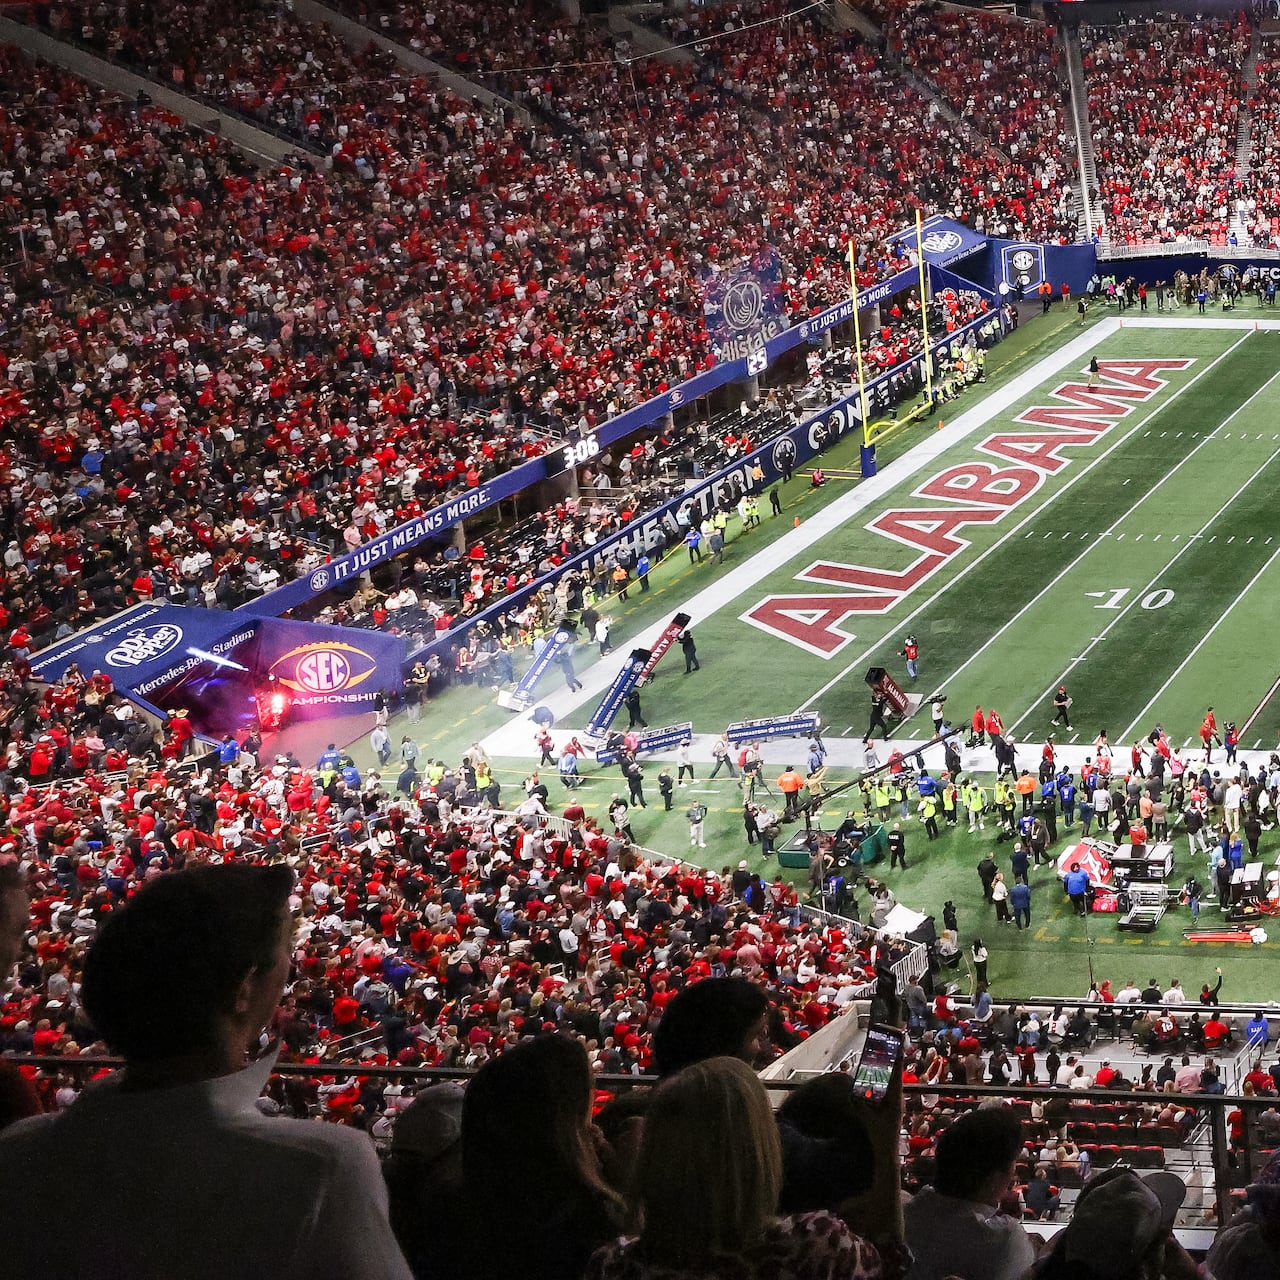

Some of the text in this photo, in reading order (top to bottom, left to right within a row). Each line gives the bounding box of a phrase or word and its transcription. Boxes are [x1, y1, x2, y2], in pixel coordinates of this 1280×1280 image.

[820, 311, 839, 329] JUST
[721, 321, 777, 362] Allstate
[563, 431, 601, 469] 3:06
[737, 357, 1197, 660] ALABAMA
[334, 560, 349, 580] IT
[350, 539, 389, 571] JUST
[392, 514, 443, 552] MEANS
[1093, 587, 1176, 610] 10
[102, 607, 160, 637] CONFERENCE
[133, 628, 255, 696] Mercedes-Ben Stadium
[299, 651, 346, 690] SEC
[648, 732, 689, 747] CONFERENCE
